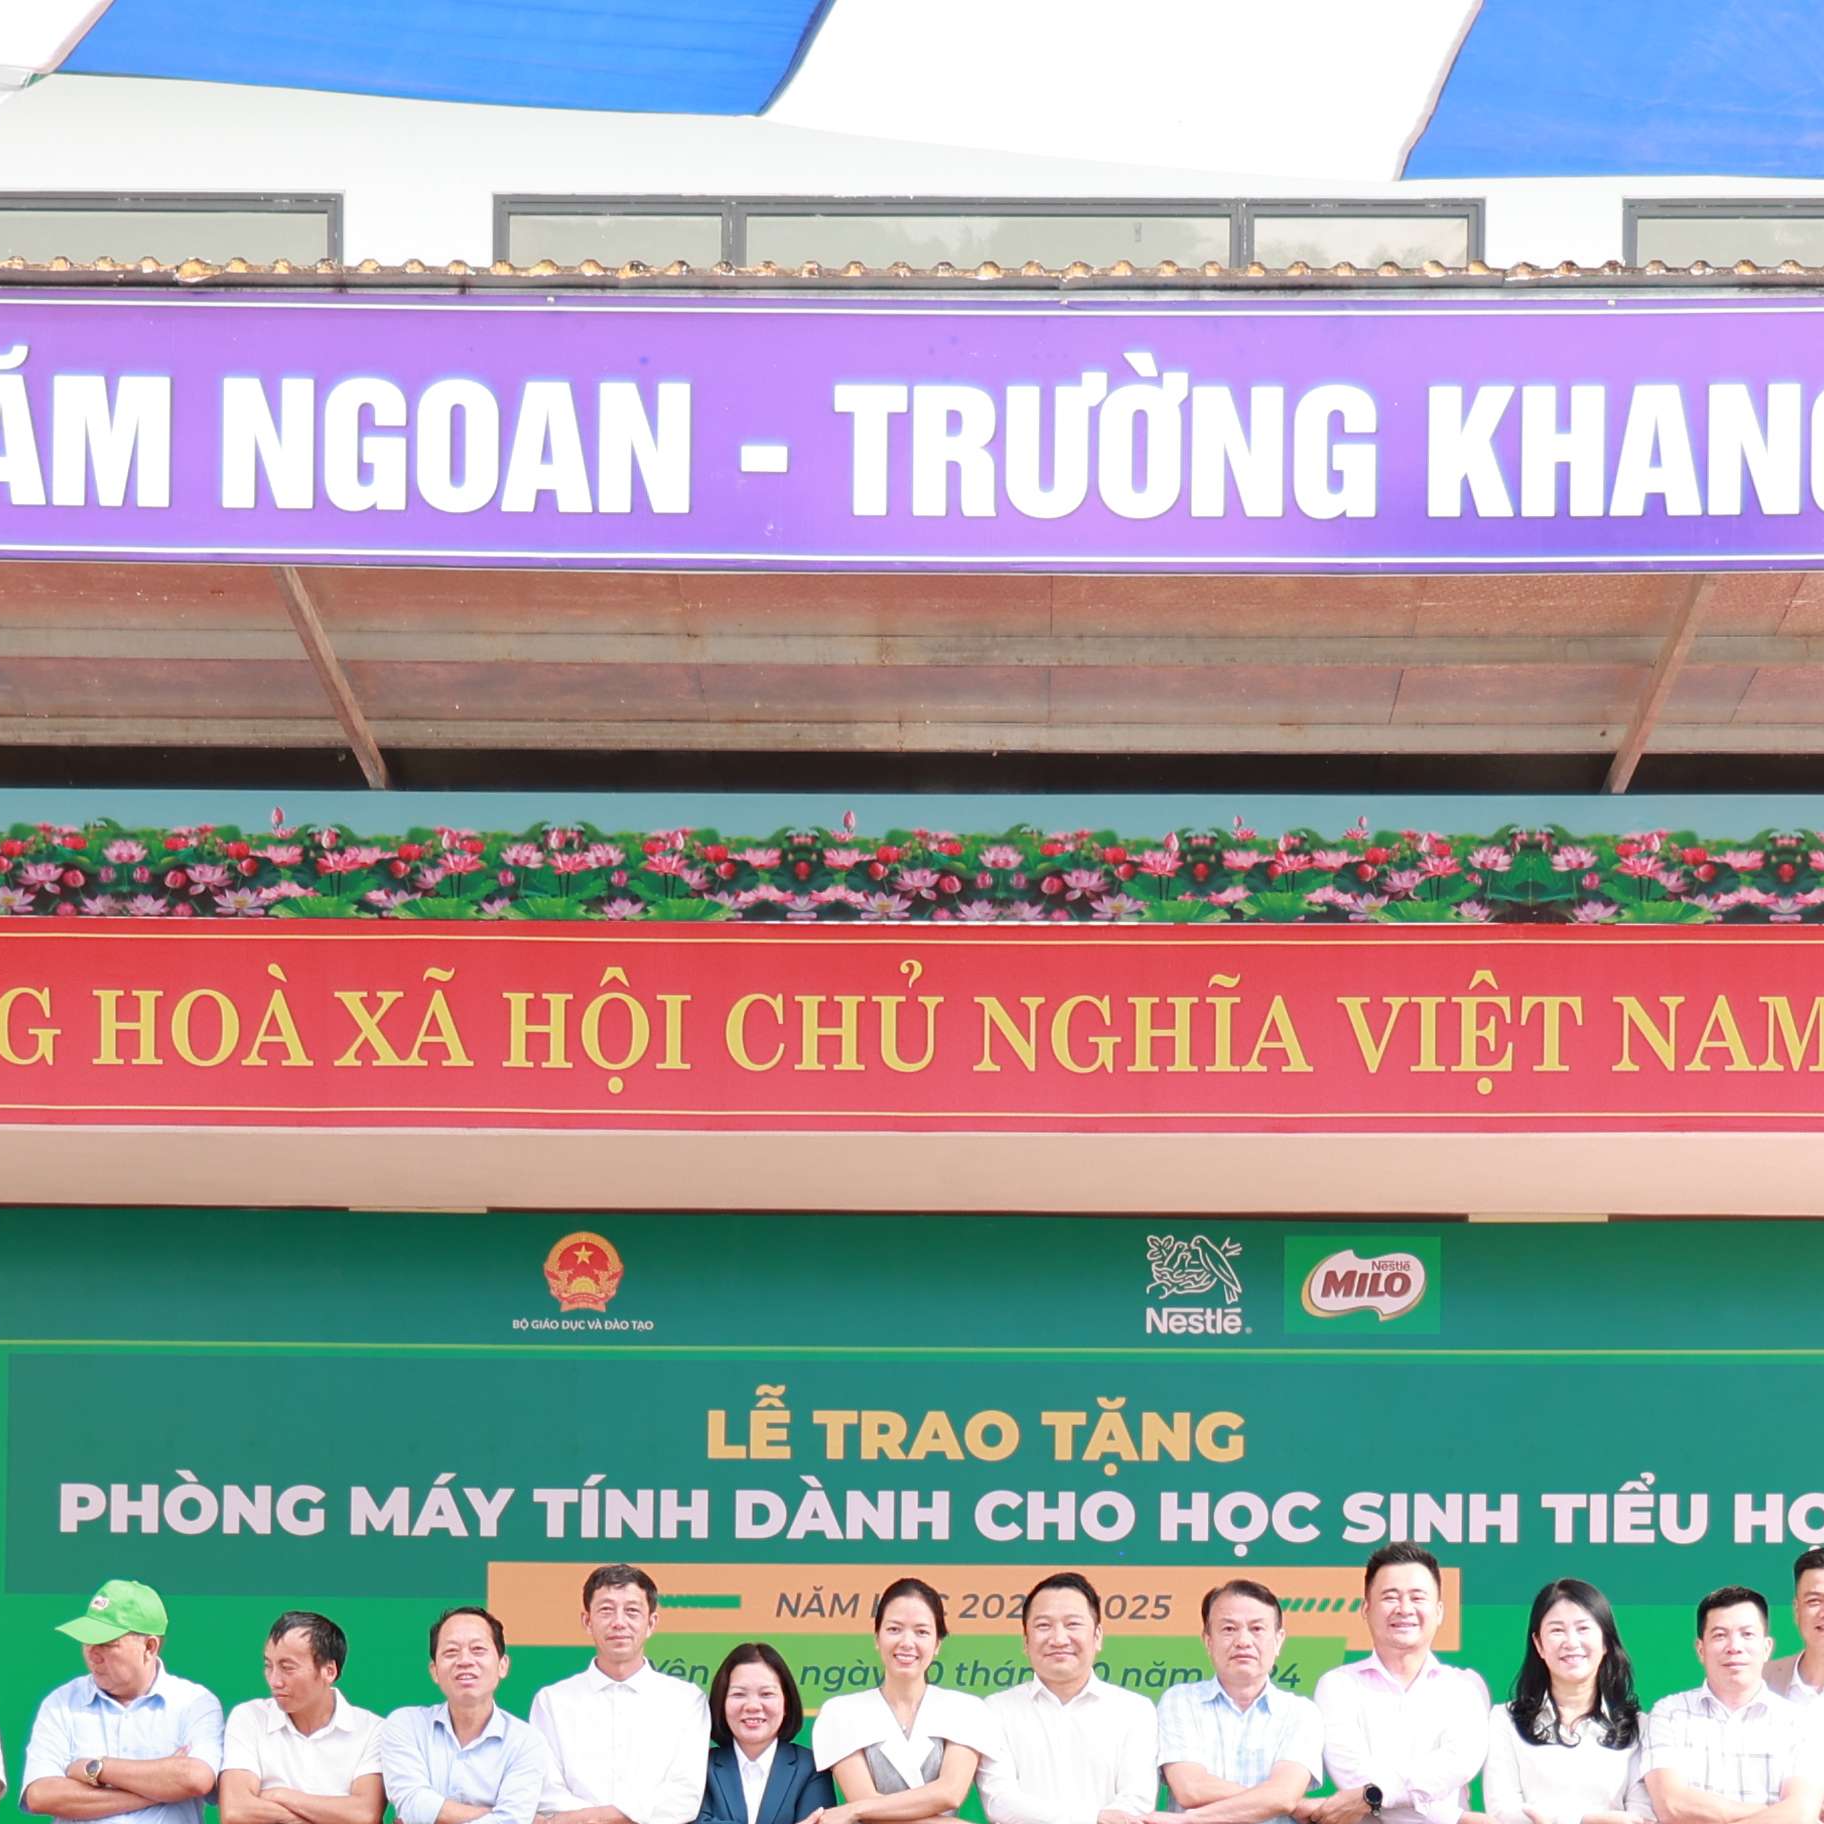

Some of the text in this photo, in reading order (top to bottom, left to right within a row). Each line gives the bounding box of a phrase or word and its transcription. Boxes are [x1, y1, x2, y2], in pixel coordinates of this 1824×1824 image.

[222, 377, 691, 513] NGOAN
[741, 444, 788, 472] -
[834, 353, 1377, 519] TRƯỜNG
[93, 963, 316, 1068] HOÀ
[334, 967, 475, 1070] XÃ
[502, 967, 692, 1094] HỘI
[725, 960, 945, 1073] CHỦ
[973, 973, 1313, 1074] NGHĨA
[1336, 969, 1584, 1094] VIỆT
[1321, 1270, 1412, 1298] MILO
[512, 1318, 654, 1332] BỘ GIÁO DỤC VÀ ĐÀO TẠO
[1146, 1307, 1242, 1335] Nestlé
[707, 1385, 1245, 1477] LỄ TRAO TẶNG
[60, 1471, 326, 1537] PHÒNG
[350, 1472, 515, 1538] MÁY
[534, 1474, 709, 1539] TÍNH
[735, 1475, 950, 1540] DÀNH
[975, 1490, 1136, 1542] CHO
[1160, 1491, 1321, 1557] HỌC
[1343, 1492, 1518, 1544] SINH
[1542, 1471, 1708, 1545] TIỂU
[776, 1586, 859, 1619] NĂM
[959, 1592, 1026, 1619] 202
[1104, 1593, 1172, 1620] 025
[955, 1660, 1035, 1689] thán
